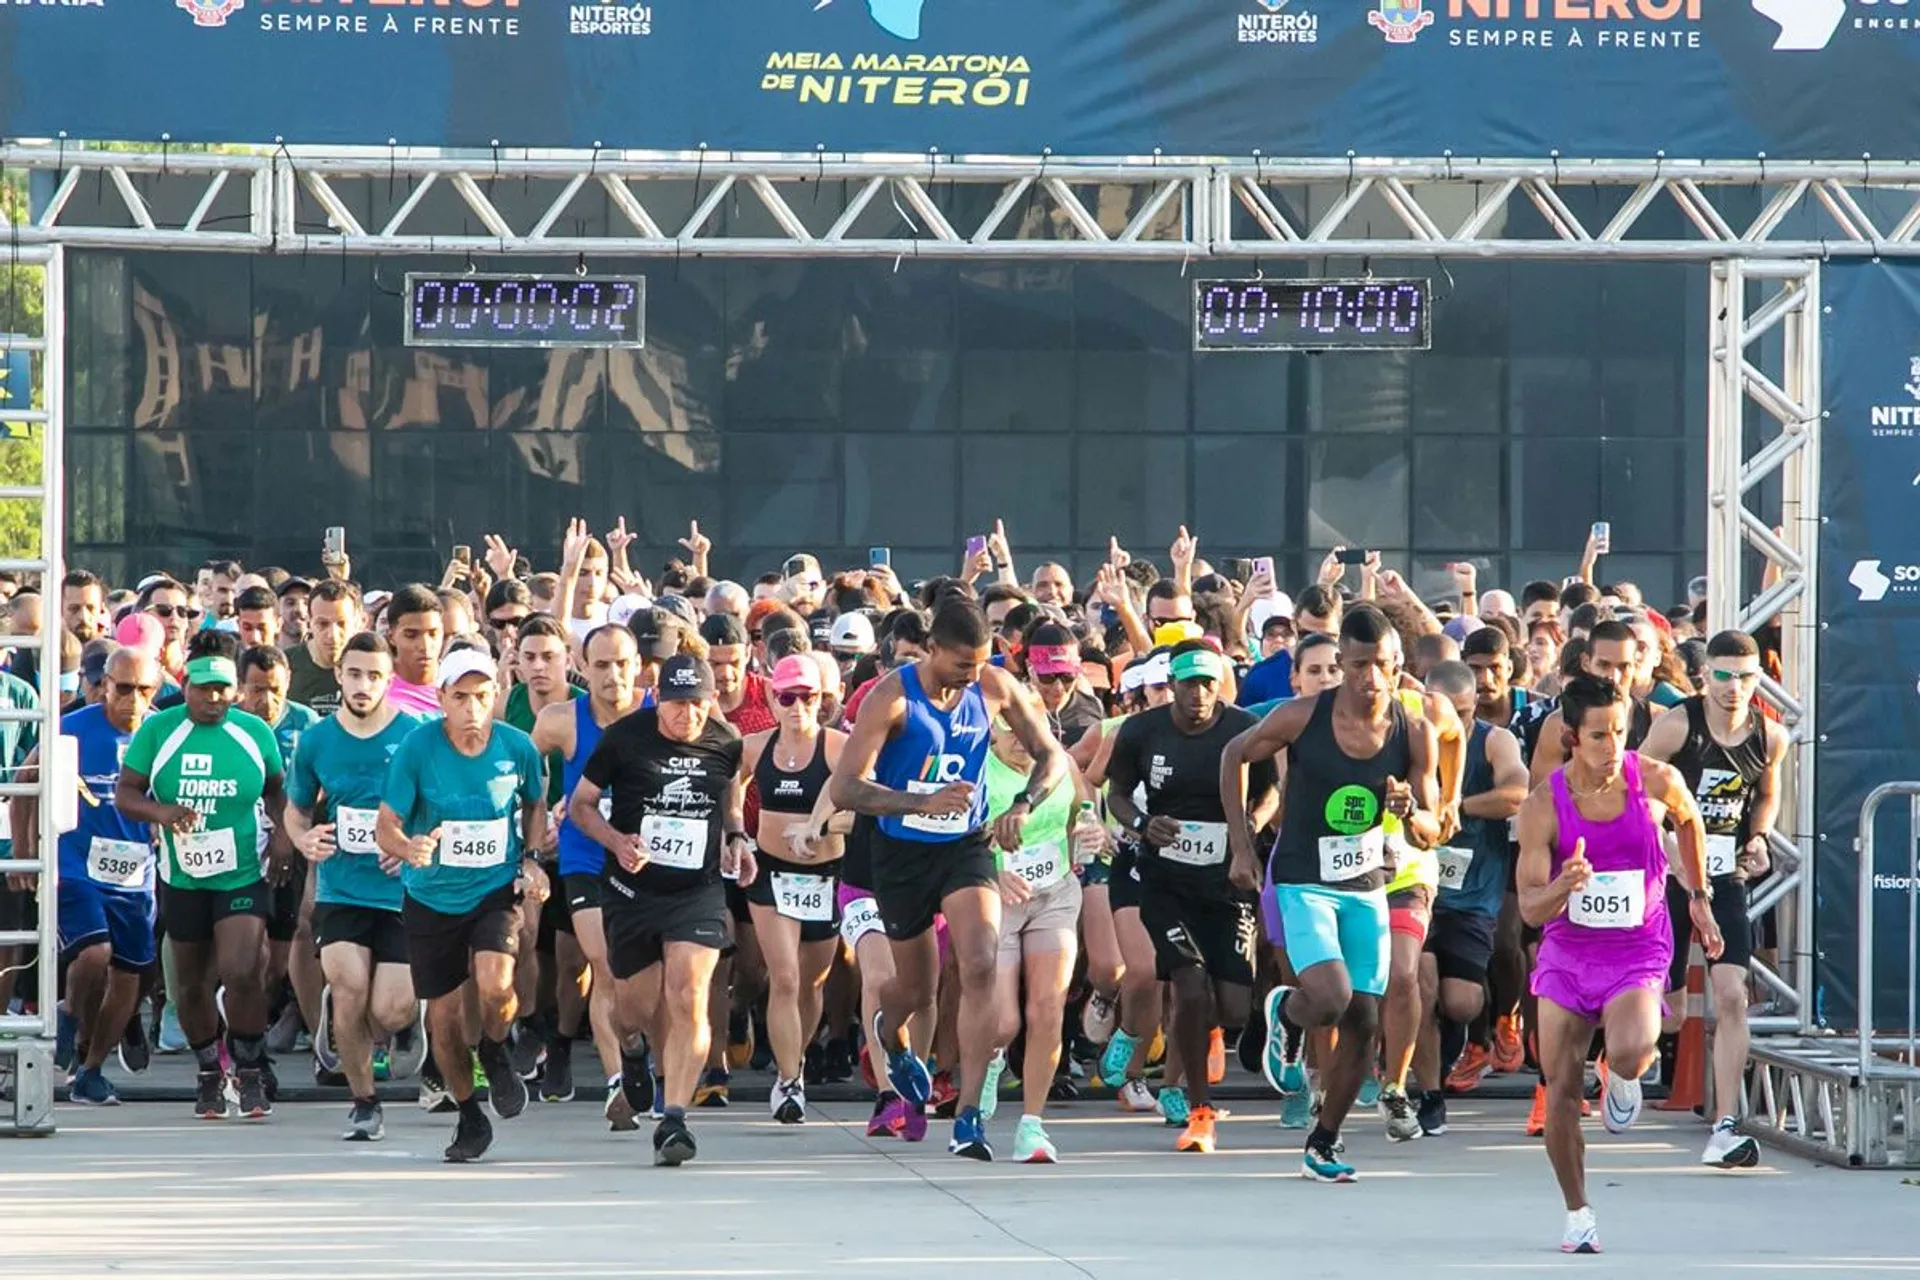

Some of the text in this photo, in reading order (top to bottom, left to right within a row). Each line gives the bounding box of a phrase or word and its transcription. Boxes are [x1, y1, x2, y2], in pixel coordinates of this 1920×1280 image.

[570, 2, 651, 22] NITERÓI
[1238, 10, 1318, 30] NITERÓI
[260, 13, 368, 33] SEMPRE
[383, 12, 399, 33] À
[414, 16, 519, 36] FRENTE
[570, 21, 651, 35] ESPORTES
[1238, 30, 1317, 43] ESPORTES
[1449, 27, 1701, 48] SEMPRE À FRENTE
[766, 51, 1031, 73] MEIA MARATONA
[761, 72, 1030, 106] DE NITERÓI
[415, 281, 635, 330] 00:00:02
[669, 756, 701, 768] CIEP
[178, 779, 238, 797] TORRES
[452, 840, 497, 856] 5486
[650, 836, 693, 856] 5471
[98, 857, 138, 875] 5389
[184, 848, 225, 867] 5012
[782, 892, 822, 909] 5148
[1581, 895, 1630, 913] 5051
